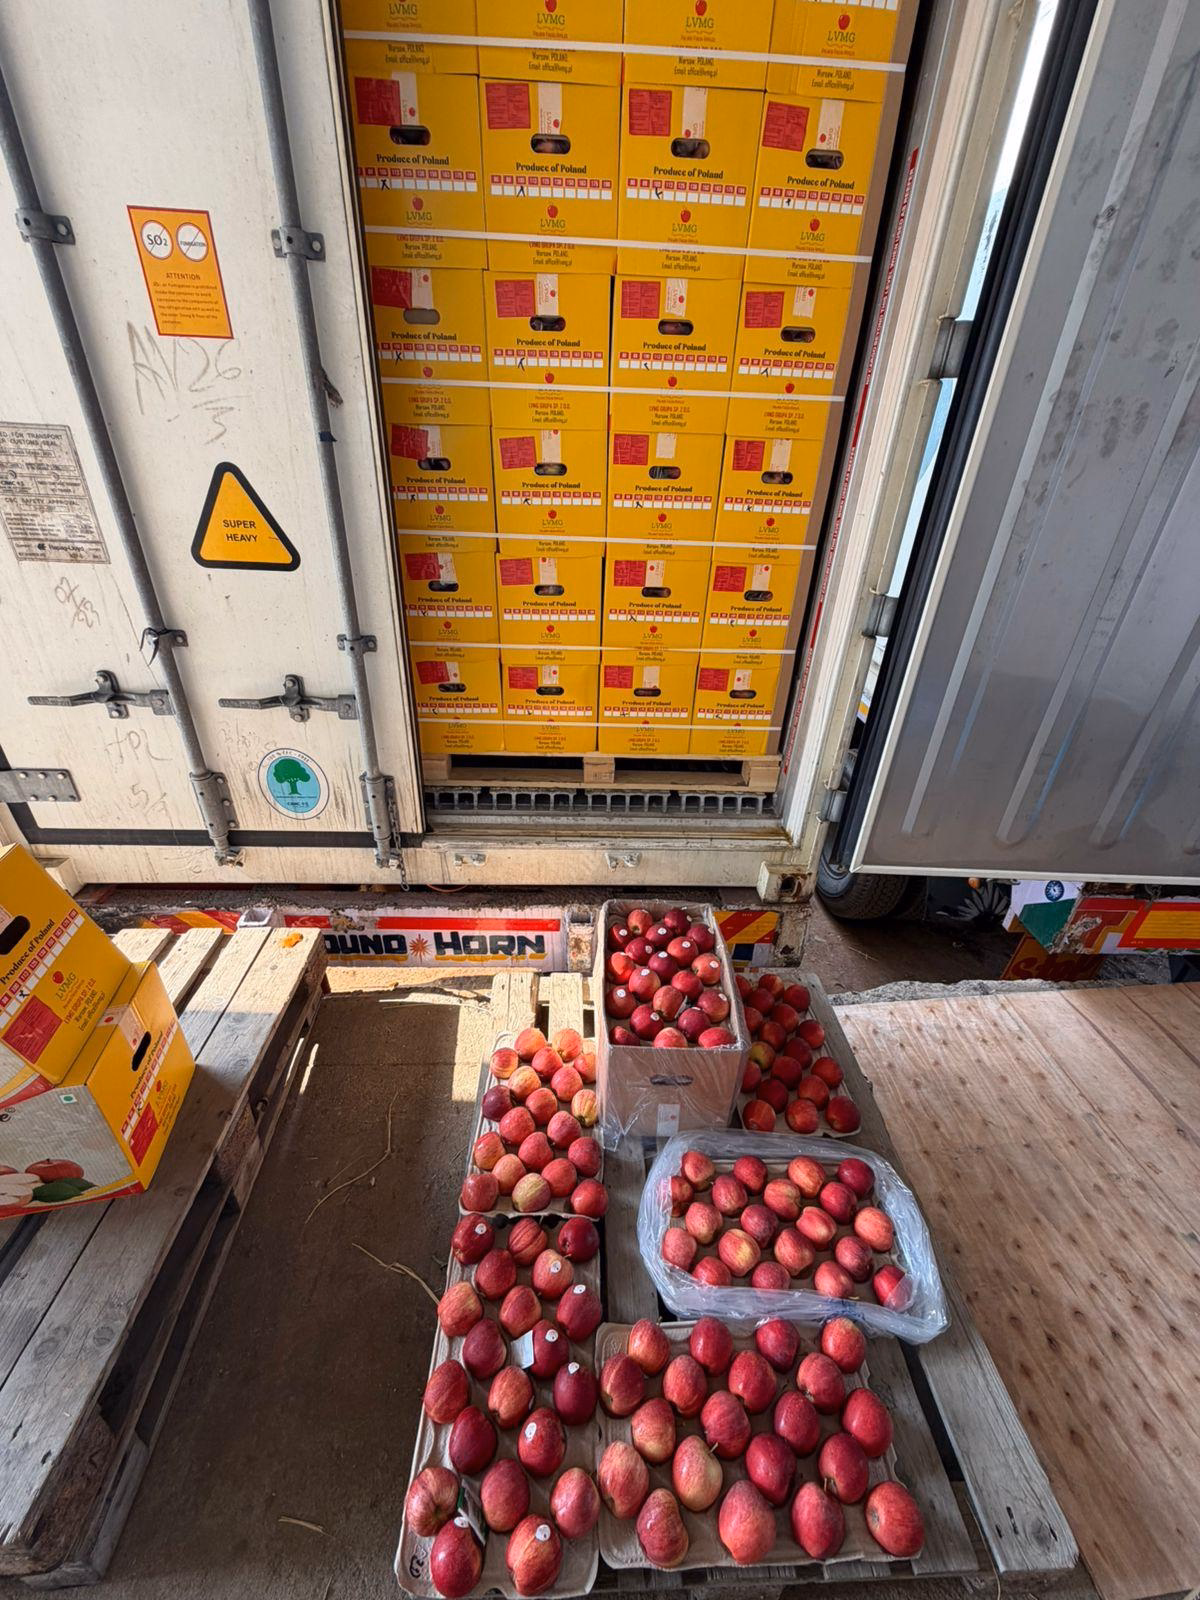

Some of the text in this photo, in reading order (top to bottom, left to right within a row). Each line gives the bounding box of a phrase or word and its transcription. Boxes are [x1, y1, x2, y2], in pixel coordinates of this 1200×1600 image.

[388, 3, 418, 16] LVMG
[537, 13, 565, 26] LVMG
[686, 18, 714, 29] LVMG
[827, 32, 856, 43] LVMG
[376, 154, 410, 165] Produce
[422, 156, 449, 166] Poland
[516, 162, 587, 174] Produce of Poland
[653, 166, 723, 180] Produce of Poland
[787, 176, 855, 190] Produce of Poland
[406, 211, 432, 221] LVMG
[540, 218, 566, 228] LVMG
[672, 223, 697, 233] LVMG
[800, 232, 825, 242] LVMG
[166, 272, 201, 281] ATTENTION
[391, 331, 422, 340] Produce
[432, 333, 457, 341] Poland
[516, 338, 546, 347] Produce
[556, 339, 580, 348] Poland
[643, 341, 672, 350] Produce
[683, 343, 706, 352] Poland
[764, 348, 793, 358] Produce
[803, 350, 826, 359] Poland
[406, 476, 434, 484] Produce
[522, 481, 549, 489] Produce
[635, 484, 662, 493] Produce
[746, 488, 772, 497] Produce
[782, 490, 803, 498] Poland
[222, 519, 256, 530] SUPER
[225, 533, 258, 543] HEAVY
[323, 932, 545, 956] OUND HORN
[0, 954, 29, 985] Produce
[35, 918, 55, 945] Poland
[55, 972, 77, 1000] LVMG
